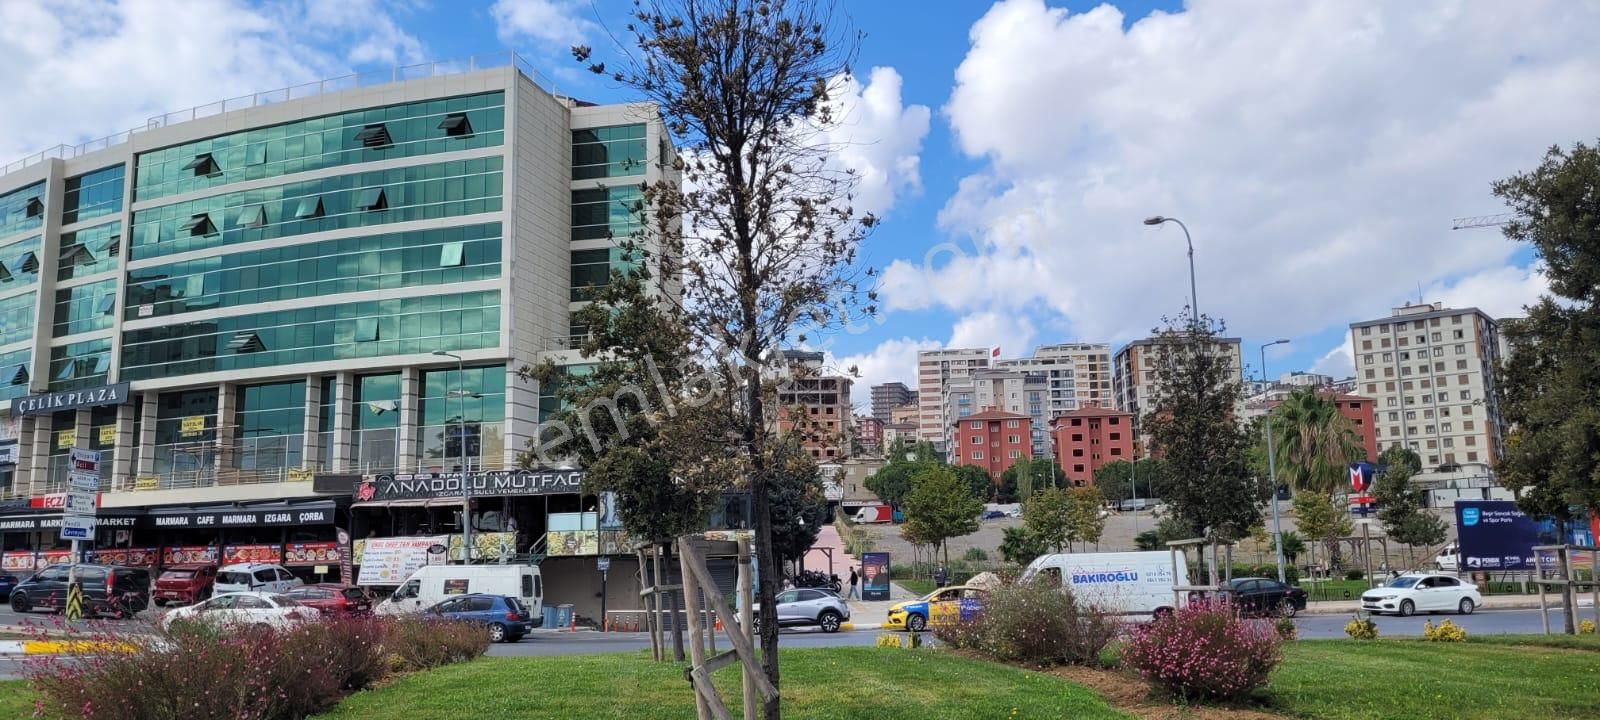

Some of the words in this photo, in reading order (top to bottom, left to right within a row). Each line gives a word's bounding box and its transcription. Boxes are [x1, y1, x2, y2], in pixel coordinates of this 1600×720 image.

[19, 393, 63, 413] ÇELİK
[68, 388, 117, 405] PLAZA
[385, 477, 486, 494] ANADOLU
[45, 496, 65, 507] ECZ
[0, 520, 35, 529] MARMARA
[40, 519, 64, 528] MARK
[95, 517, 137, 526] MARKET
[155, 517, 189, 526] MARMARA
[196, 515, 215, 525] CAFE
[222, 514, 257, 524] MARMARA
[264, 513, 292, 523] IZGARA
[299, 512, 324, 522] ÇORBA
[1072, 571, 1138, 584] BAKIROĞLU
